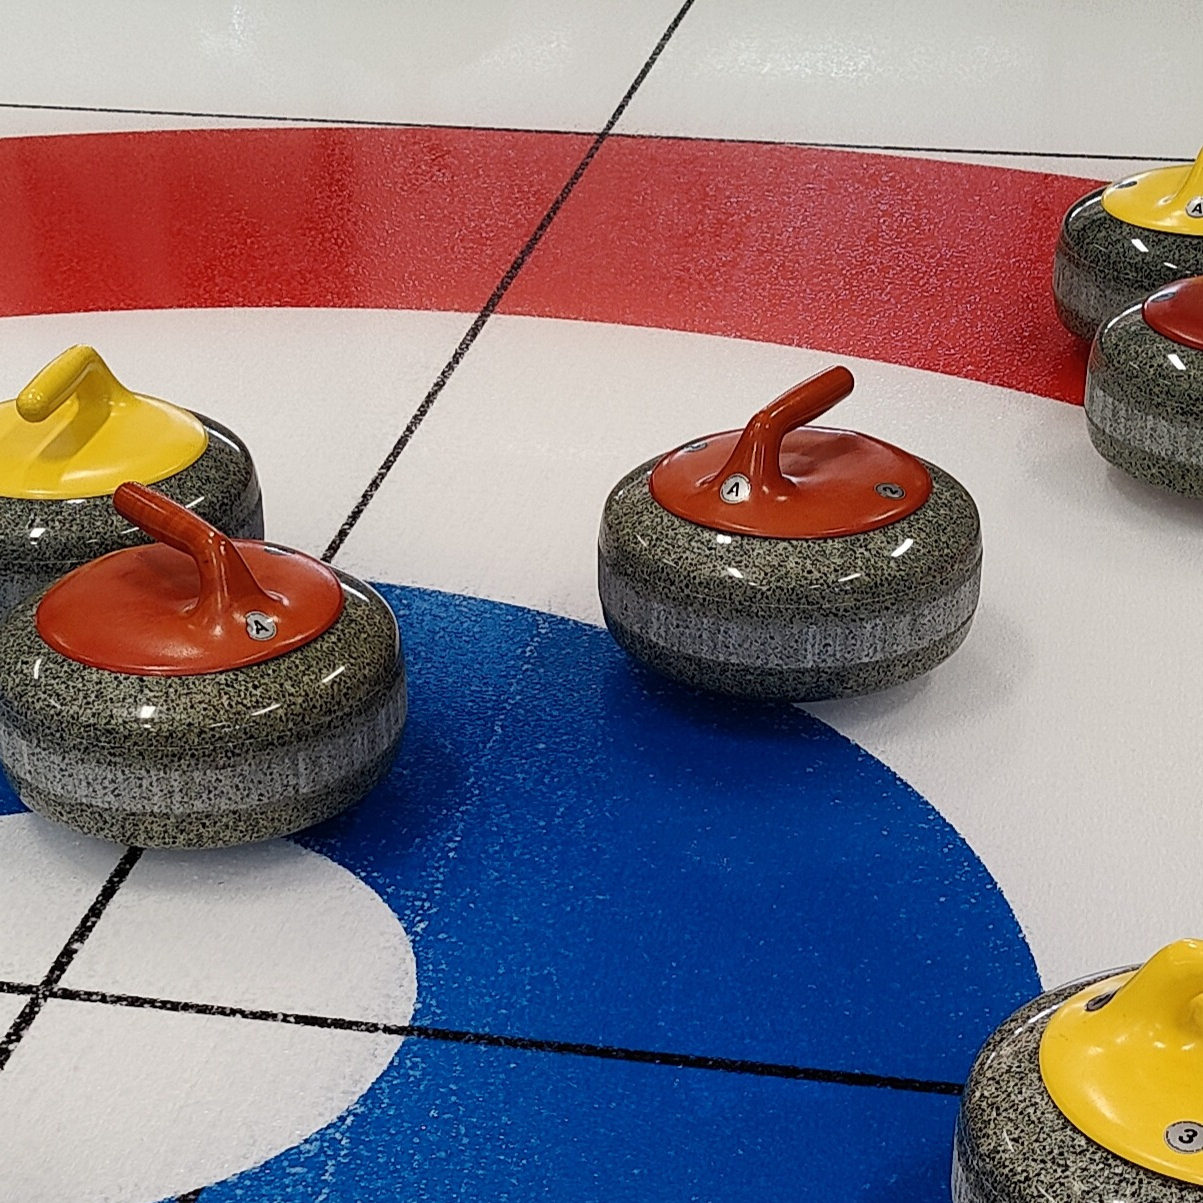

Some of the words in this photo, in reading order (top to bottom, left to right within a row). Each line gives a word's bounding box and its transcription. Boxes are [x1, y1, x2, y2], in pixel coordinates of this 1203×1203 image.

[1192, 202, 1203, 215] A
[727, 481, 740, 497] A
[253, 619, 270, 635] A
[1178, 1128, 1199, 1145] 3
